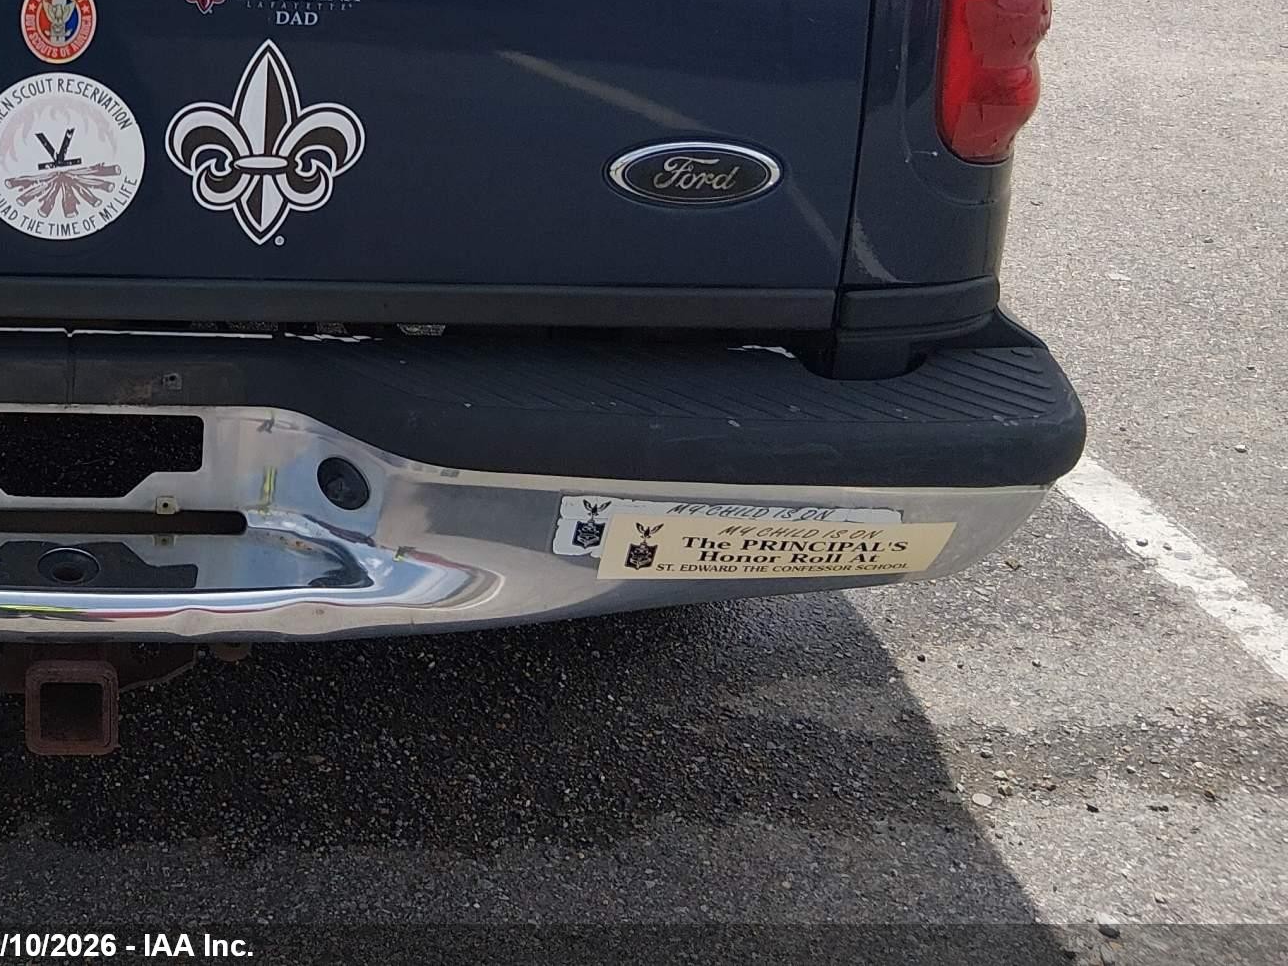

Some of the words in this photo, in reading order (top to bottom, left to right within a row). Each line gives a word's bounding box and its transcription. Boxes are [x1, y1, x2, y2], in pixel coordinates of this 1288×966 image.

[275, 10, 318, 26] DAD
[28, 32, 58, 58] SCOUTS
[59, 46, 71, 58] OF
[11, 78, 53, 105] SCOUT
[57, 77, 133, 130] RESERVATION
[652, 156, 741, 190] Ford
[20, 215, 45, 235] THE
[48, 221, 81, 237] TIME
[82, 215, 97, 232] OF
[98, 202, 120, 223] MY
[113, 176, 138, 207] LIFE
[666, 504, 701, 515] MY
[704, 505, 770, 519] CHILD
[773, 508, 797, 519] IS
[800, 509, 836, 520] ON
[718, 525, 757, 536] MY
[757, 527, 820, 539] CHILD
[822, 529, 849, 539] IS
[849, 529, 885, 540] ON
[682, 536, 732, 550] The
[740, 539, 909, 552] PRINCIPAL'S
[697, 550, 782, 564] Honor
[789, 553, 843, 564] Roll
[848, 553, 881, 564] At
[656, 563, 675, 572] ST.
[680, 564, 738, 573] EDWARD
[743, 565, 769, 573] THE
[772, 563, 853, 573] CONFESSOR
[854, 562, 910, 571] SCHOOL
